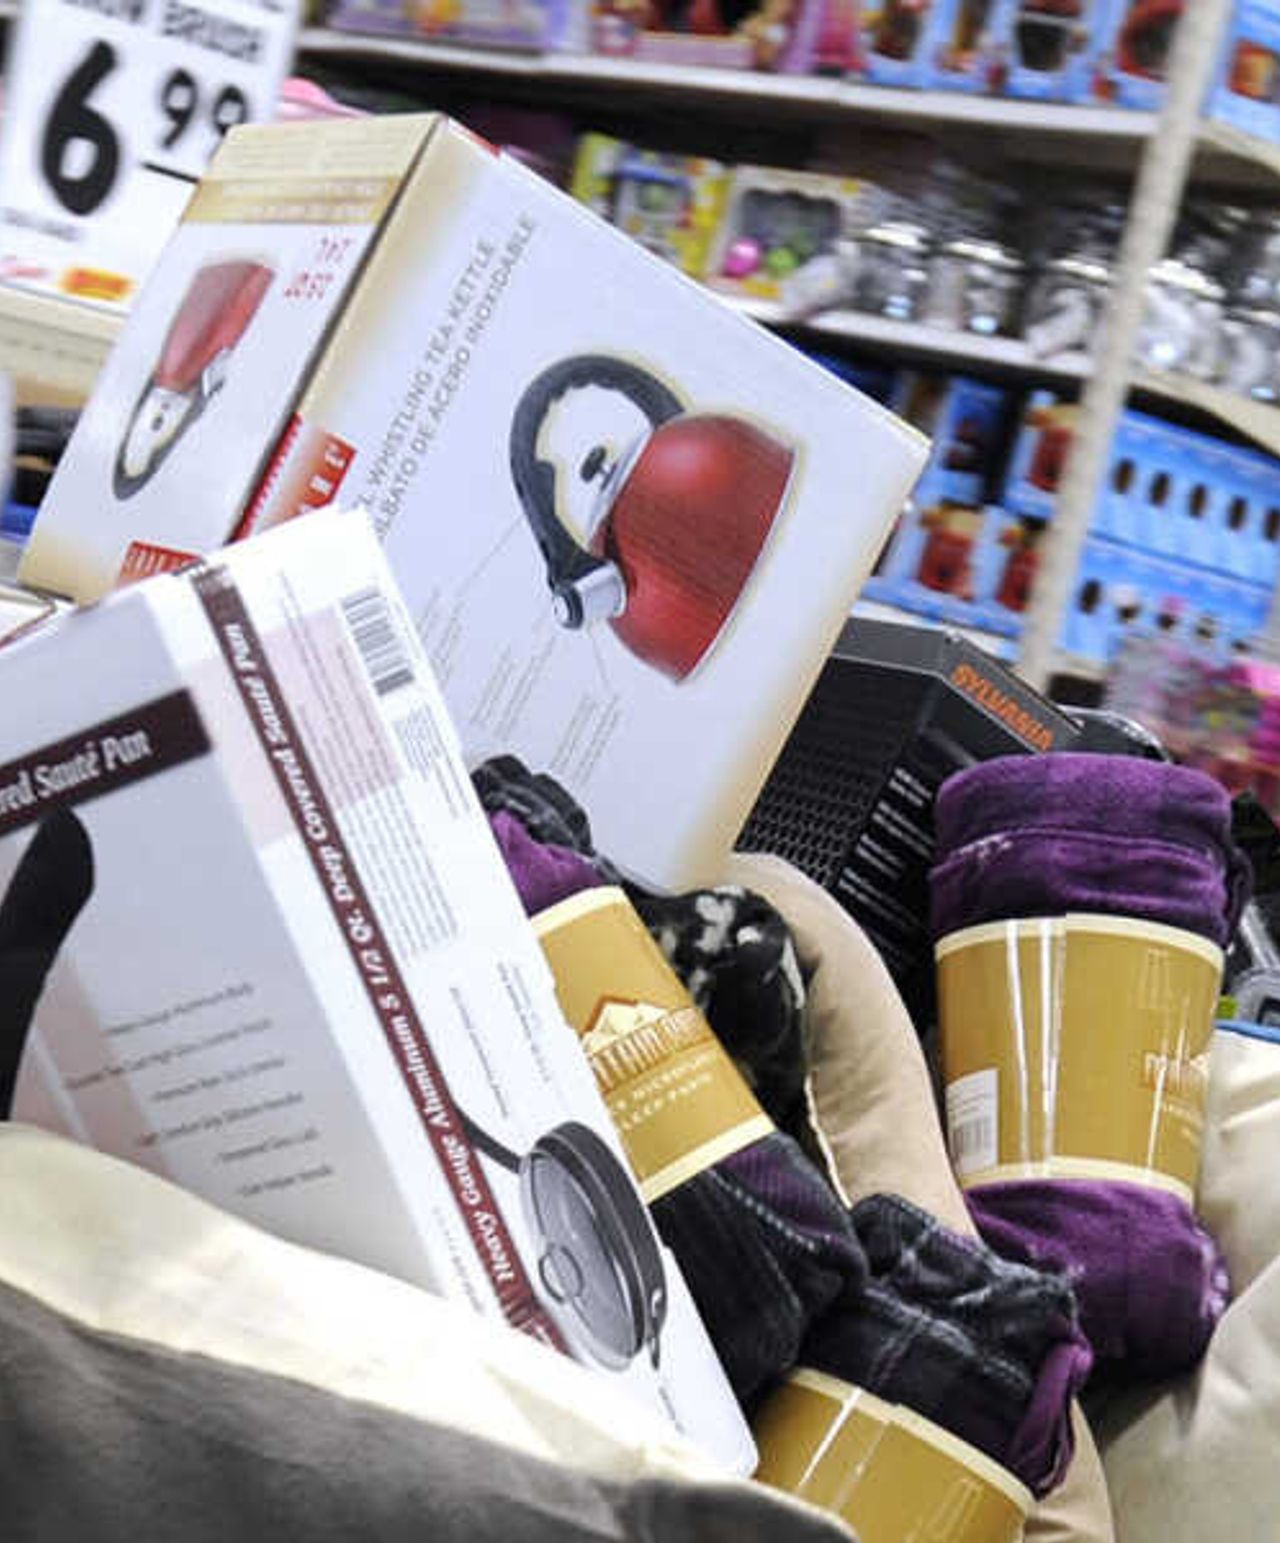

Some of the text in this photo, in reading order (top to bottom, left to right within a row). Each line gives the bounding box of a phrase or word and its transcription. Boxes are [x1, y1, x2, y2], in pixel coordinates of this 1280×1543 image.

[40, 38, 120, 217] 6
[368, 238, 497, 490] WHISTLING TEA KETTLE
[407, 420, 437, 457] DE
[422, 343, 474, 425] ACERO
[464, 216, 539, 346] INOXIDABLE
[220, 619, 258, 674] Pan
[242, 673, 290, 748] Sauté
[34, 743, 101, 798] Sauté
[99, 727, 153, 771] Pan
[278, 746, 331, 842] Covered
[316, 842, 359, 905] Deep
[343, 905, 375, 946] Qt.
[359, 946, 392, 989] 1/2
[379, 991, 401, 1012] 5
[386, 1012, 452, 1132] Aluminum
[438, 1129, 487, 1207] Gauge
[469, 1207, 517, 1284] Heavy
